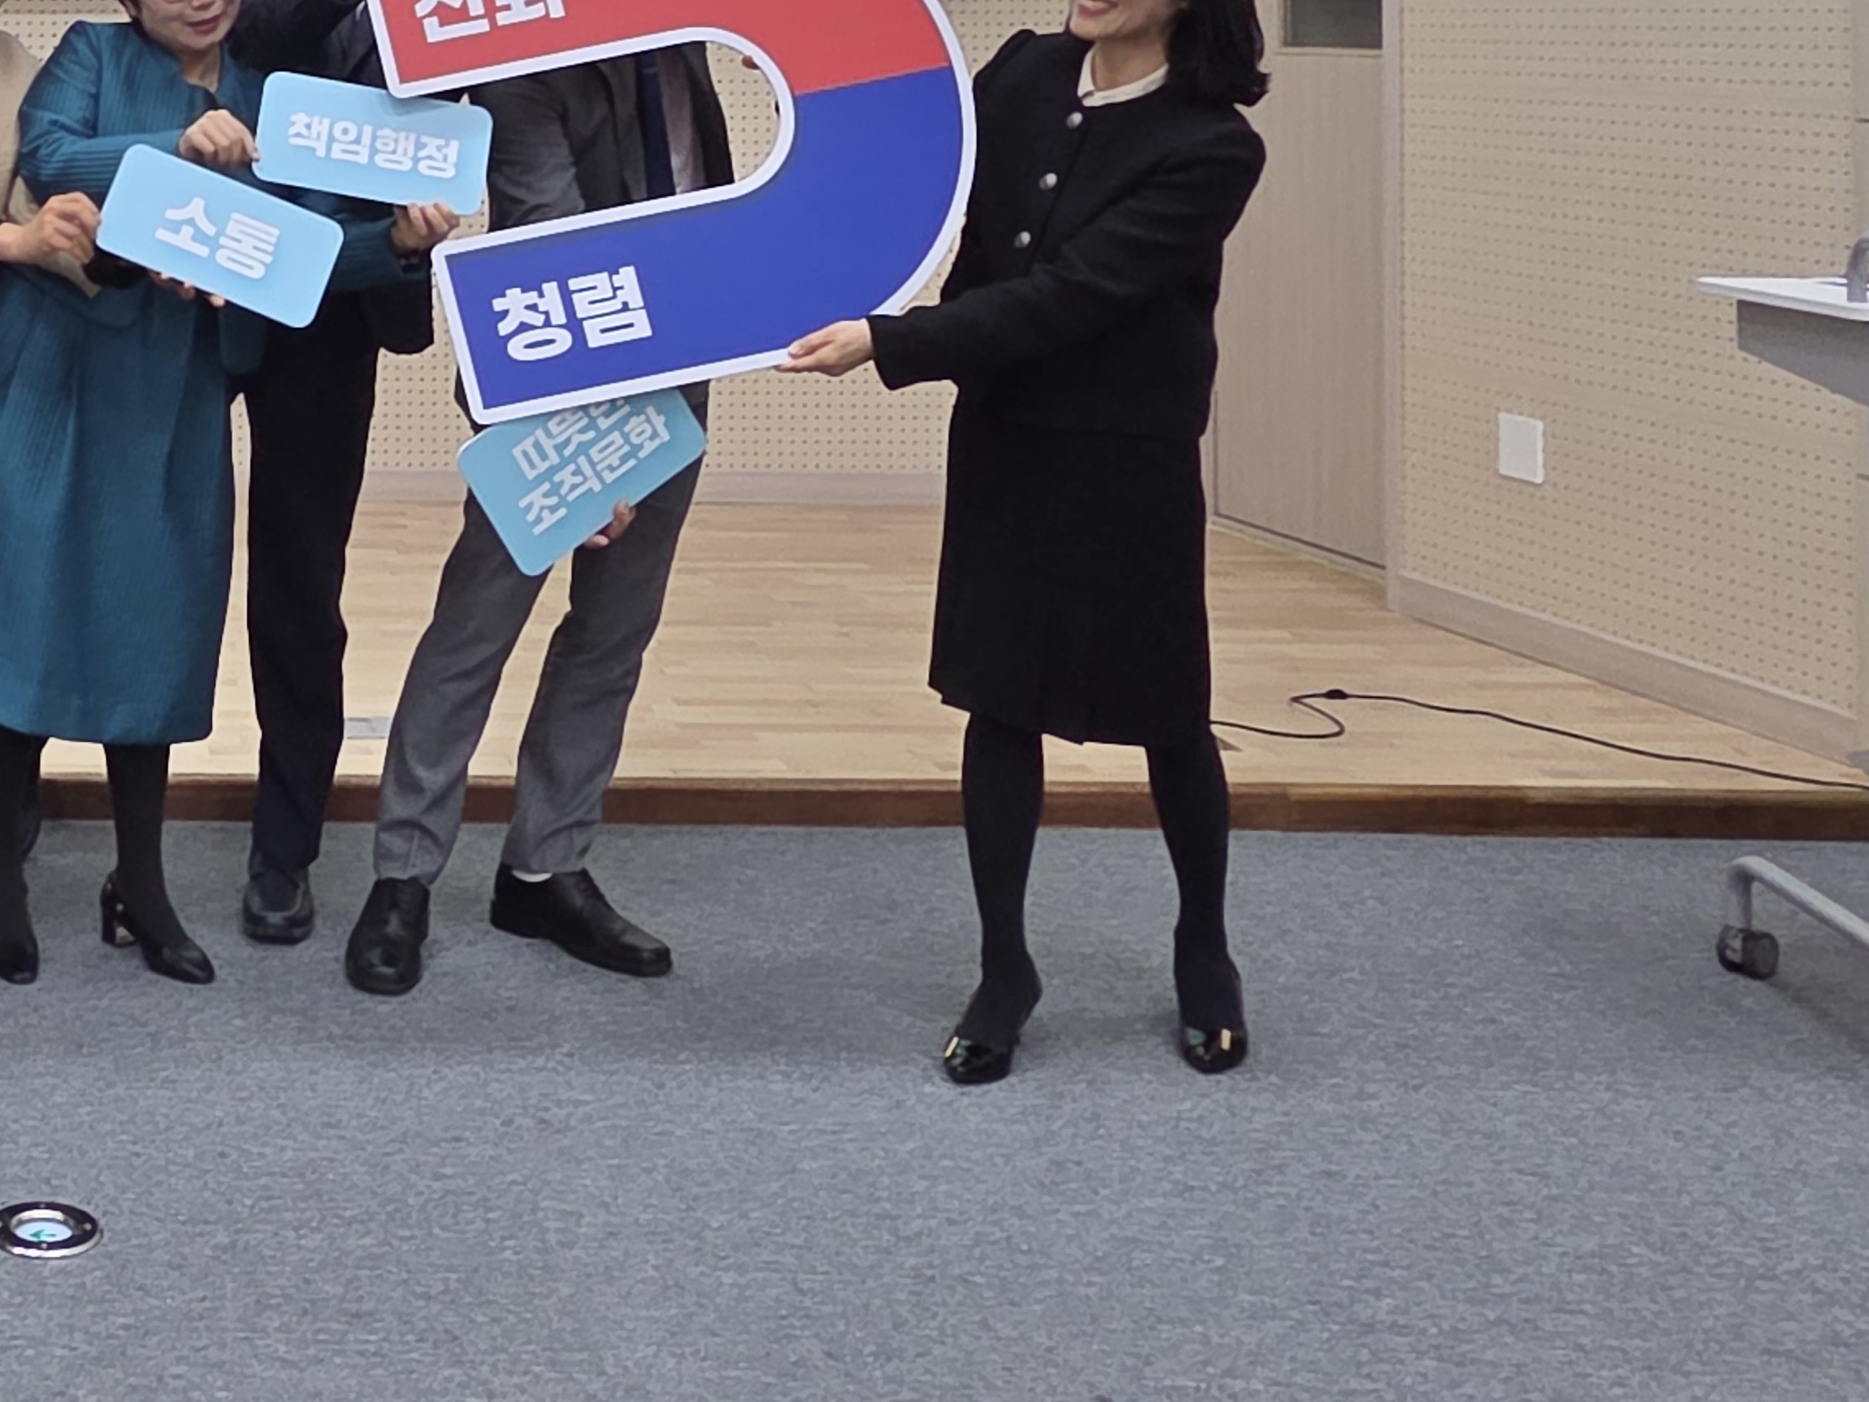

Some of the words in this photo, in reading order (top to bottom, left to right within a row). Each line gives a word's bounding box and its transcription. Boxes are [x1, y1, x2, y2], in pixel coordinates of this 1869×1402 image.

[287, 111, 460, 179] 책임행정
[154, 196, 281, 279] 소통
[492, 265, 653, 362] 청렴
[518, 405, 671, 536] 조직문화
